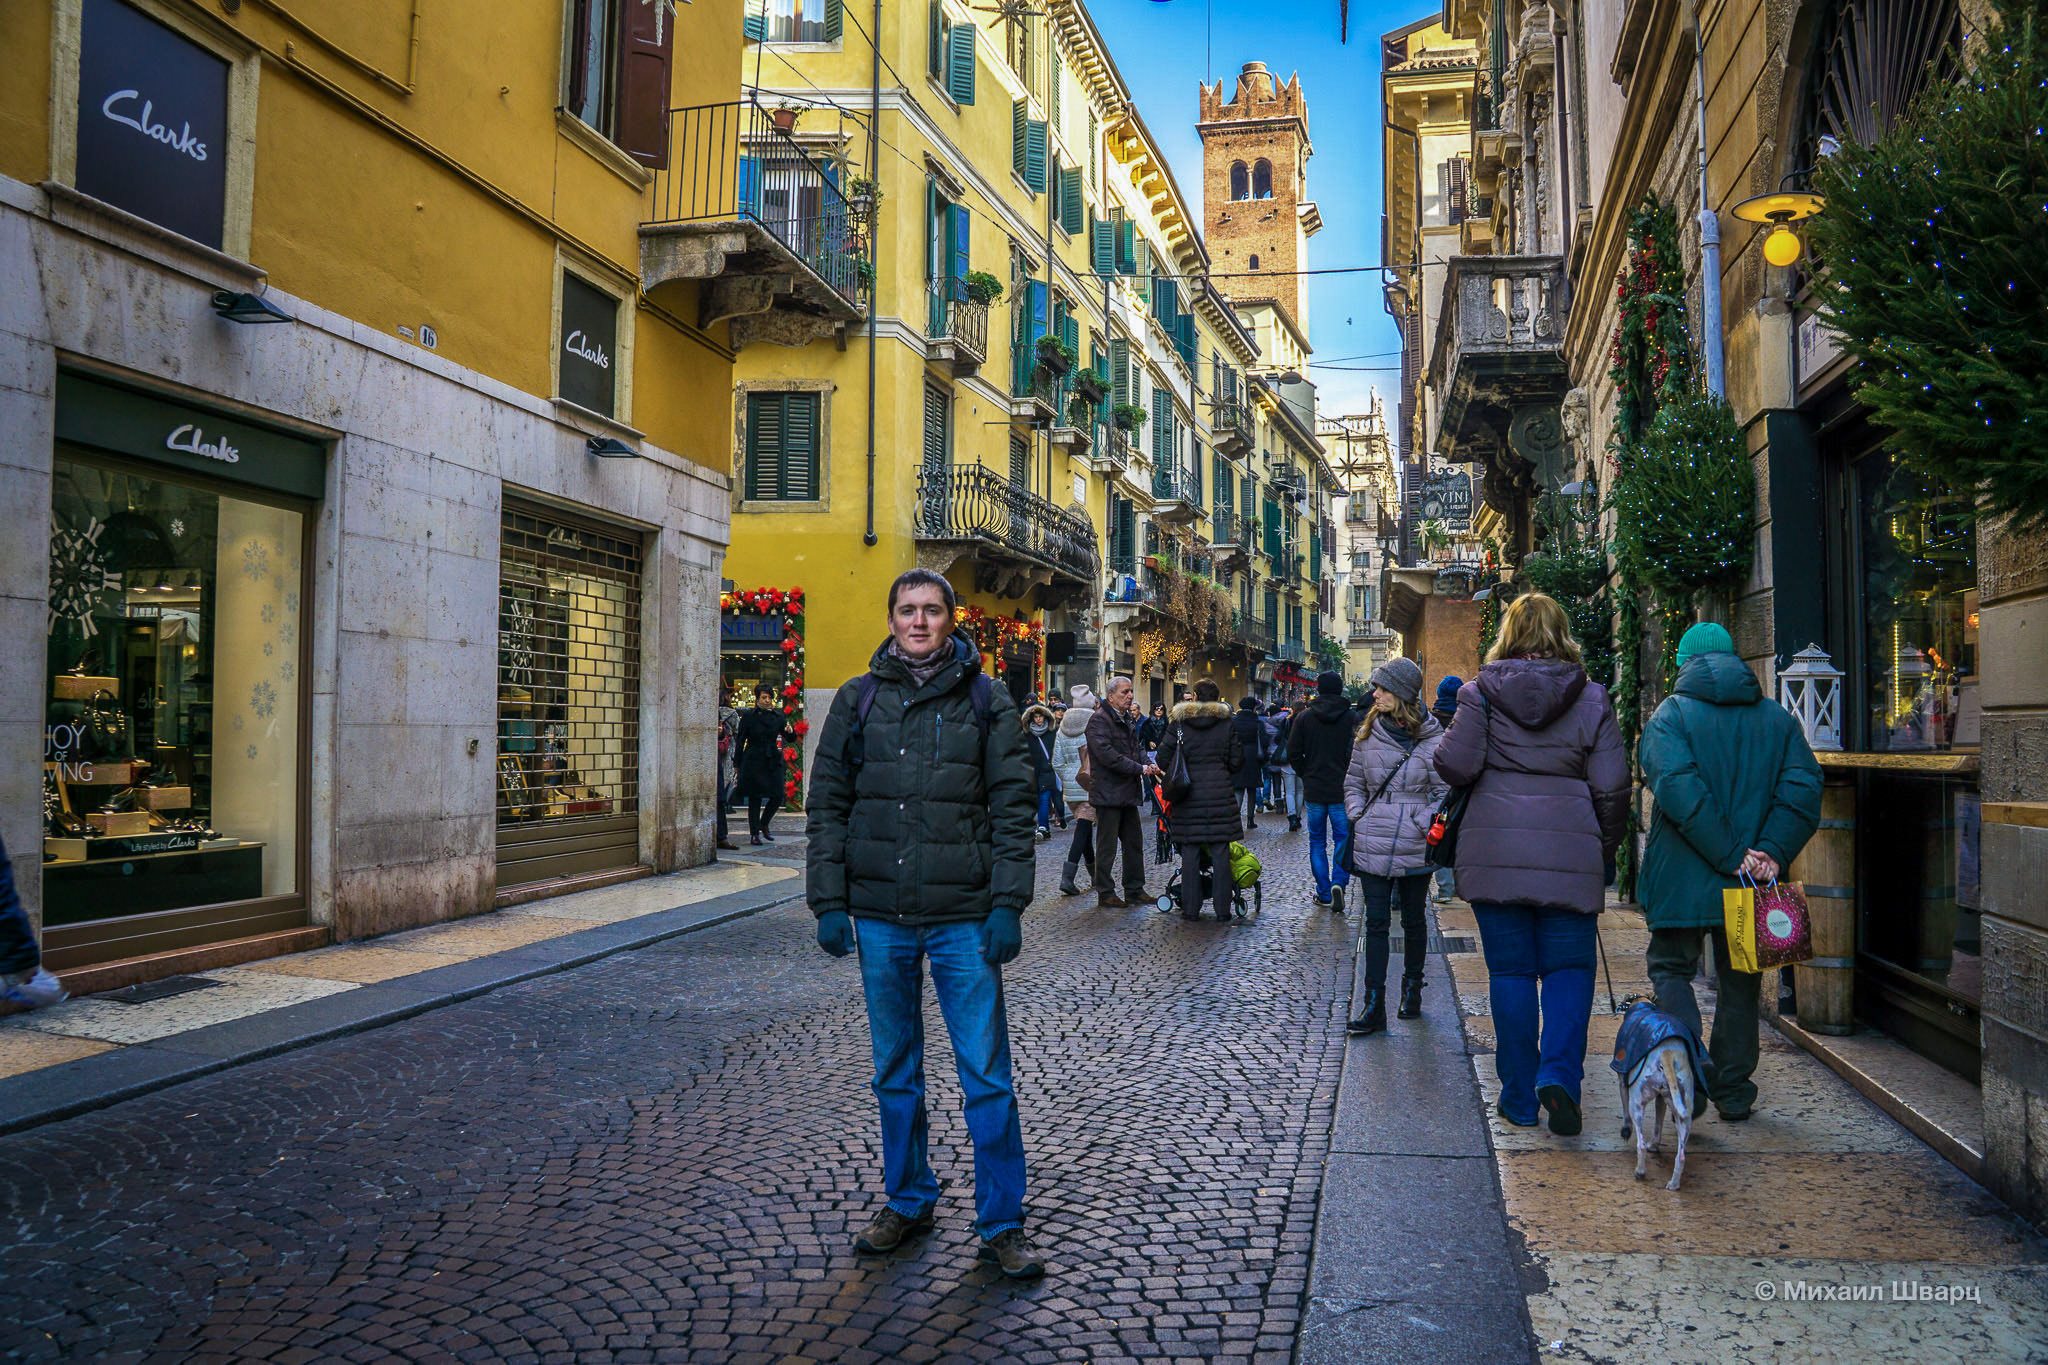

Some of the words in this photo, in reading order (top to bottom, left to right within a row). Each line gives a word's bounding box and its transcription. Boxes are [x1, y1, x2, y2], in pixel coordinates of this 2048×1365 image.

[102, 89, 208, 161] Clarks
[422, 328, 435, 347] 16
[565, 330, 609, 369] Clarks
[166, 424, 240, 463] Clarks
[720, 621, 778, 637] NETTI
[44, 724, 87, 756] JOY
[54, 750, 68, 761] OF
[167, 837, 196, 849] Clarks
